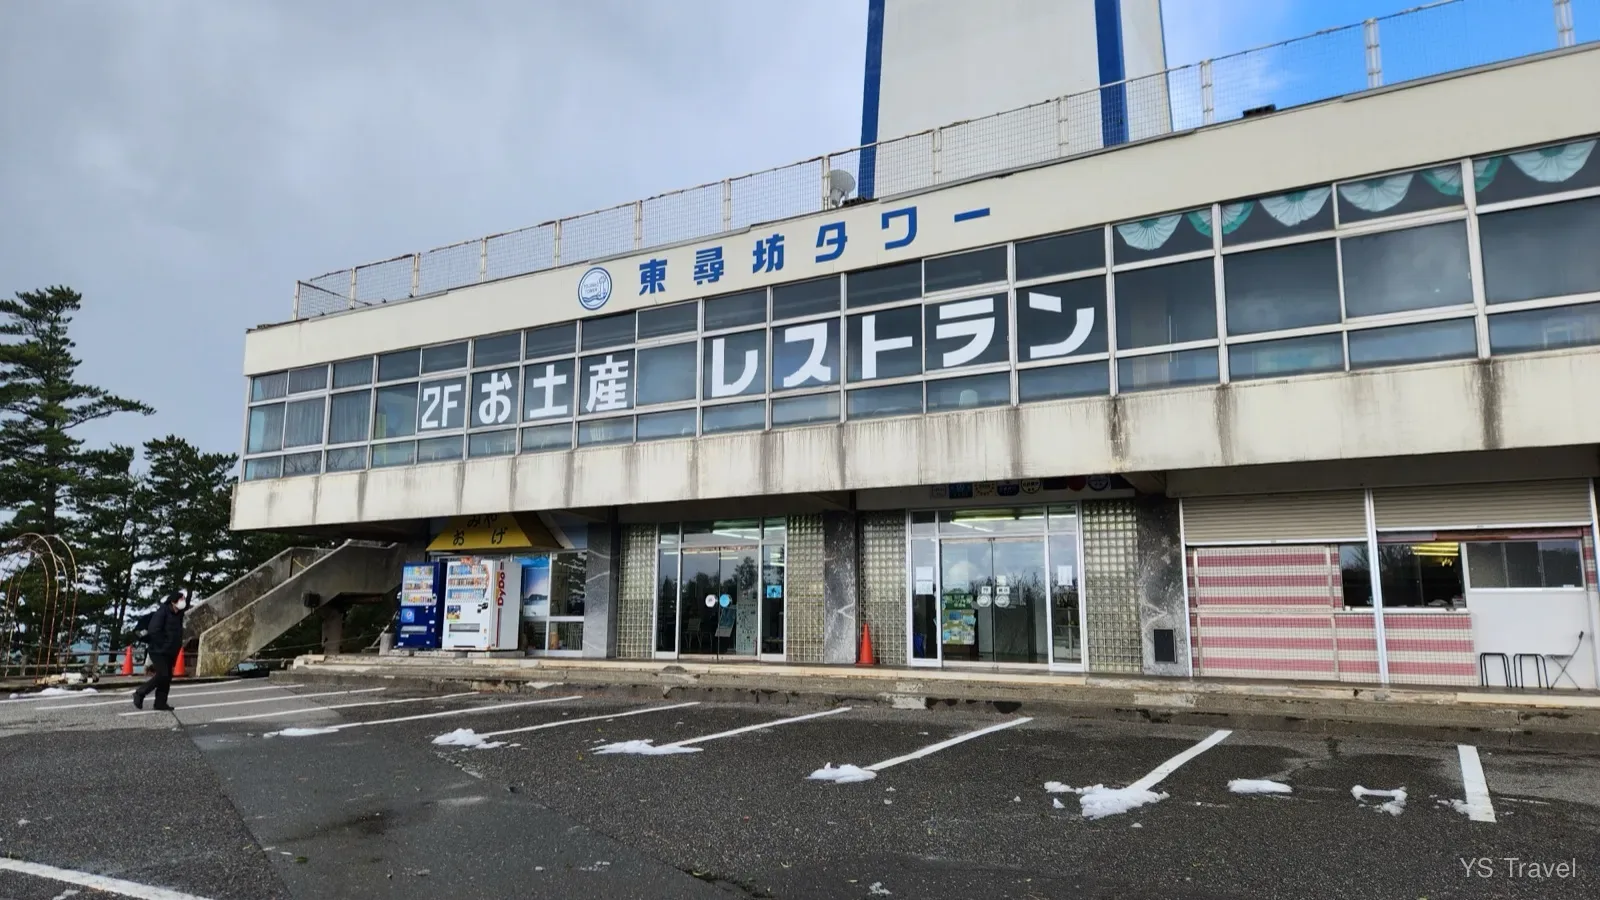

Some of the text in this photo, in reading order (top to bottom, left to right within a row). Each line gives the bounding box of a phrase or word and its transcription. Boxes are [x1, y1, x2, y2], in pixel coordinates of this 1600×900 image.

[639, 206, 991, 296] 東尋坊タワー
[711, 292, 1095, 398] レストラン
